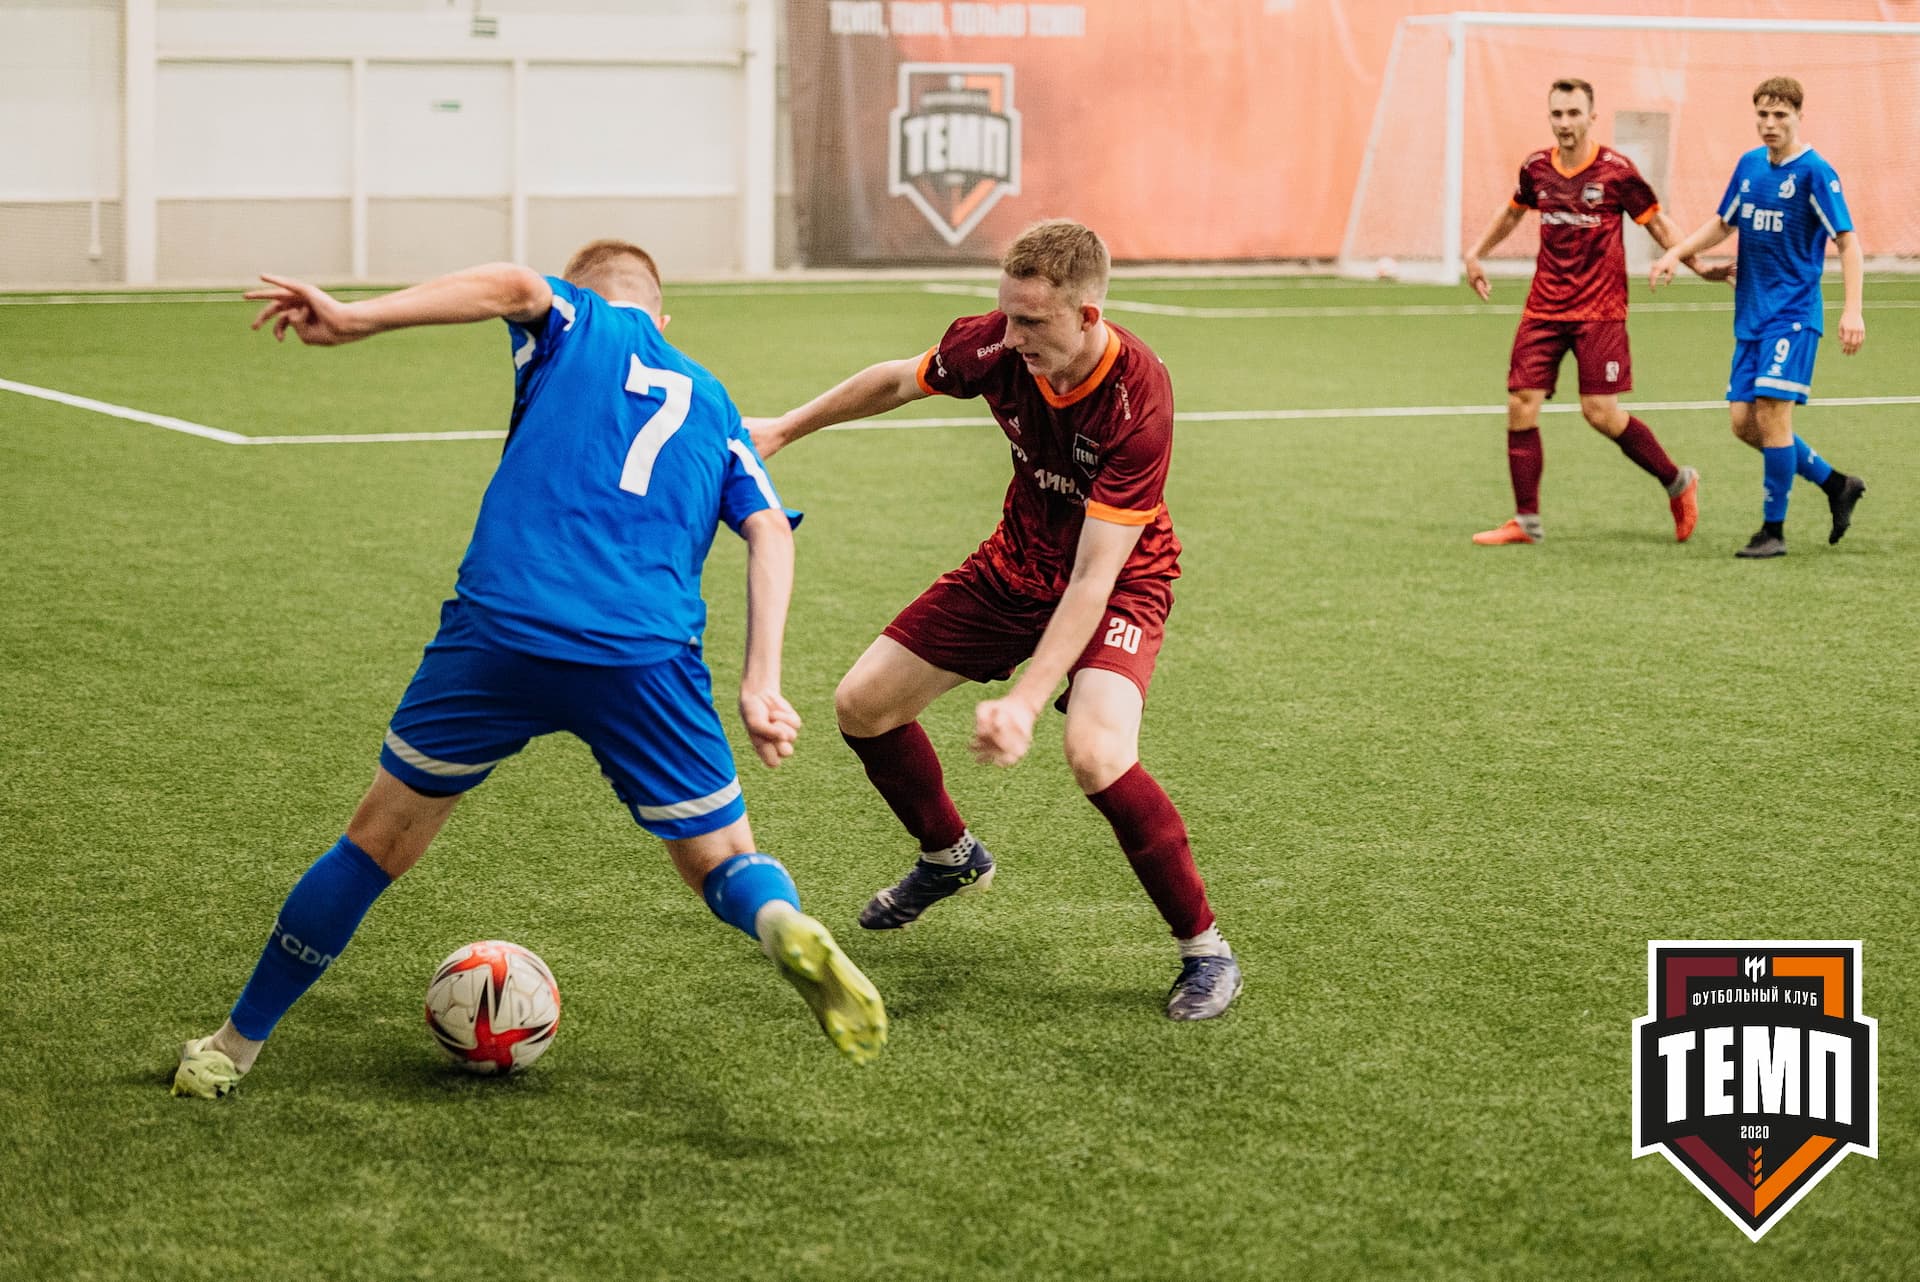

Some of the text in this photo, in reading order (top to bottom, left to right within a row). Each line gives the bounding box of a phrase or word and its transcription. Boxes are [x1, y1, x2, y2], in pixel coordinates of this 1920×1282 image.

[903, 112, 1010, 179] ТЕМП
[1753, 208, 1784, 232] ВТБ
[1773, 337, 1791, 364] 9
[618, 352, 694, 497] 7
[1103, 616, 1143, 655] 20
